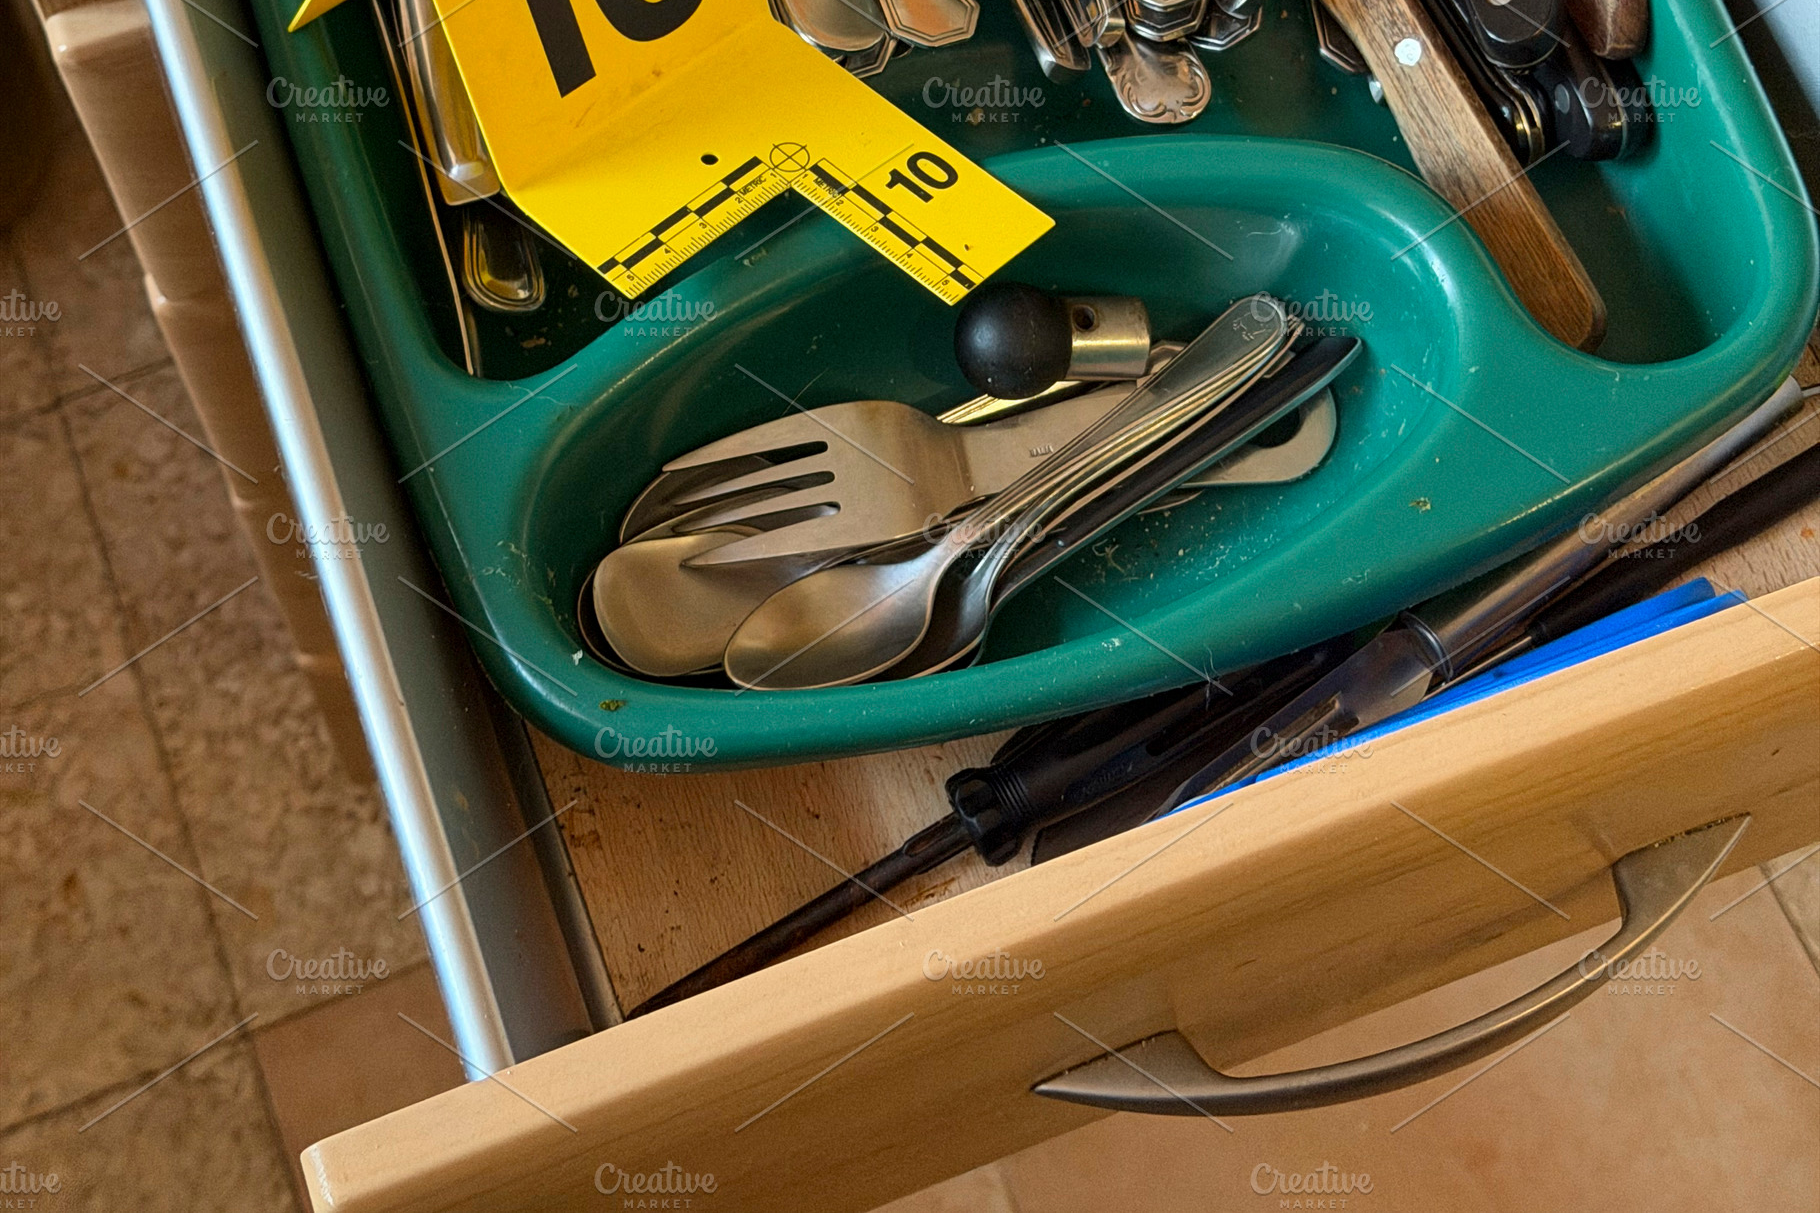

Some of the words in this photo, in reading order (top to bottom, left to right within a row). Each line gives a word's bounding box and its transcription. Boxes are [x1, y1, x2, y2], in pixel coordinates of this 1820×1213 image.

[813, 177, 841, 198] METRIC
[870, 225, 879, 233] 3
[905, 251, 913, 259] 4
[885, 151, 959, 203] 10
[626, 274, 635, 282] 5
[664, 248, 672, 256] 4
[699, 222, 708, 230] 3
[738, 175, 767, 196] METRIC
